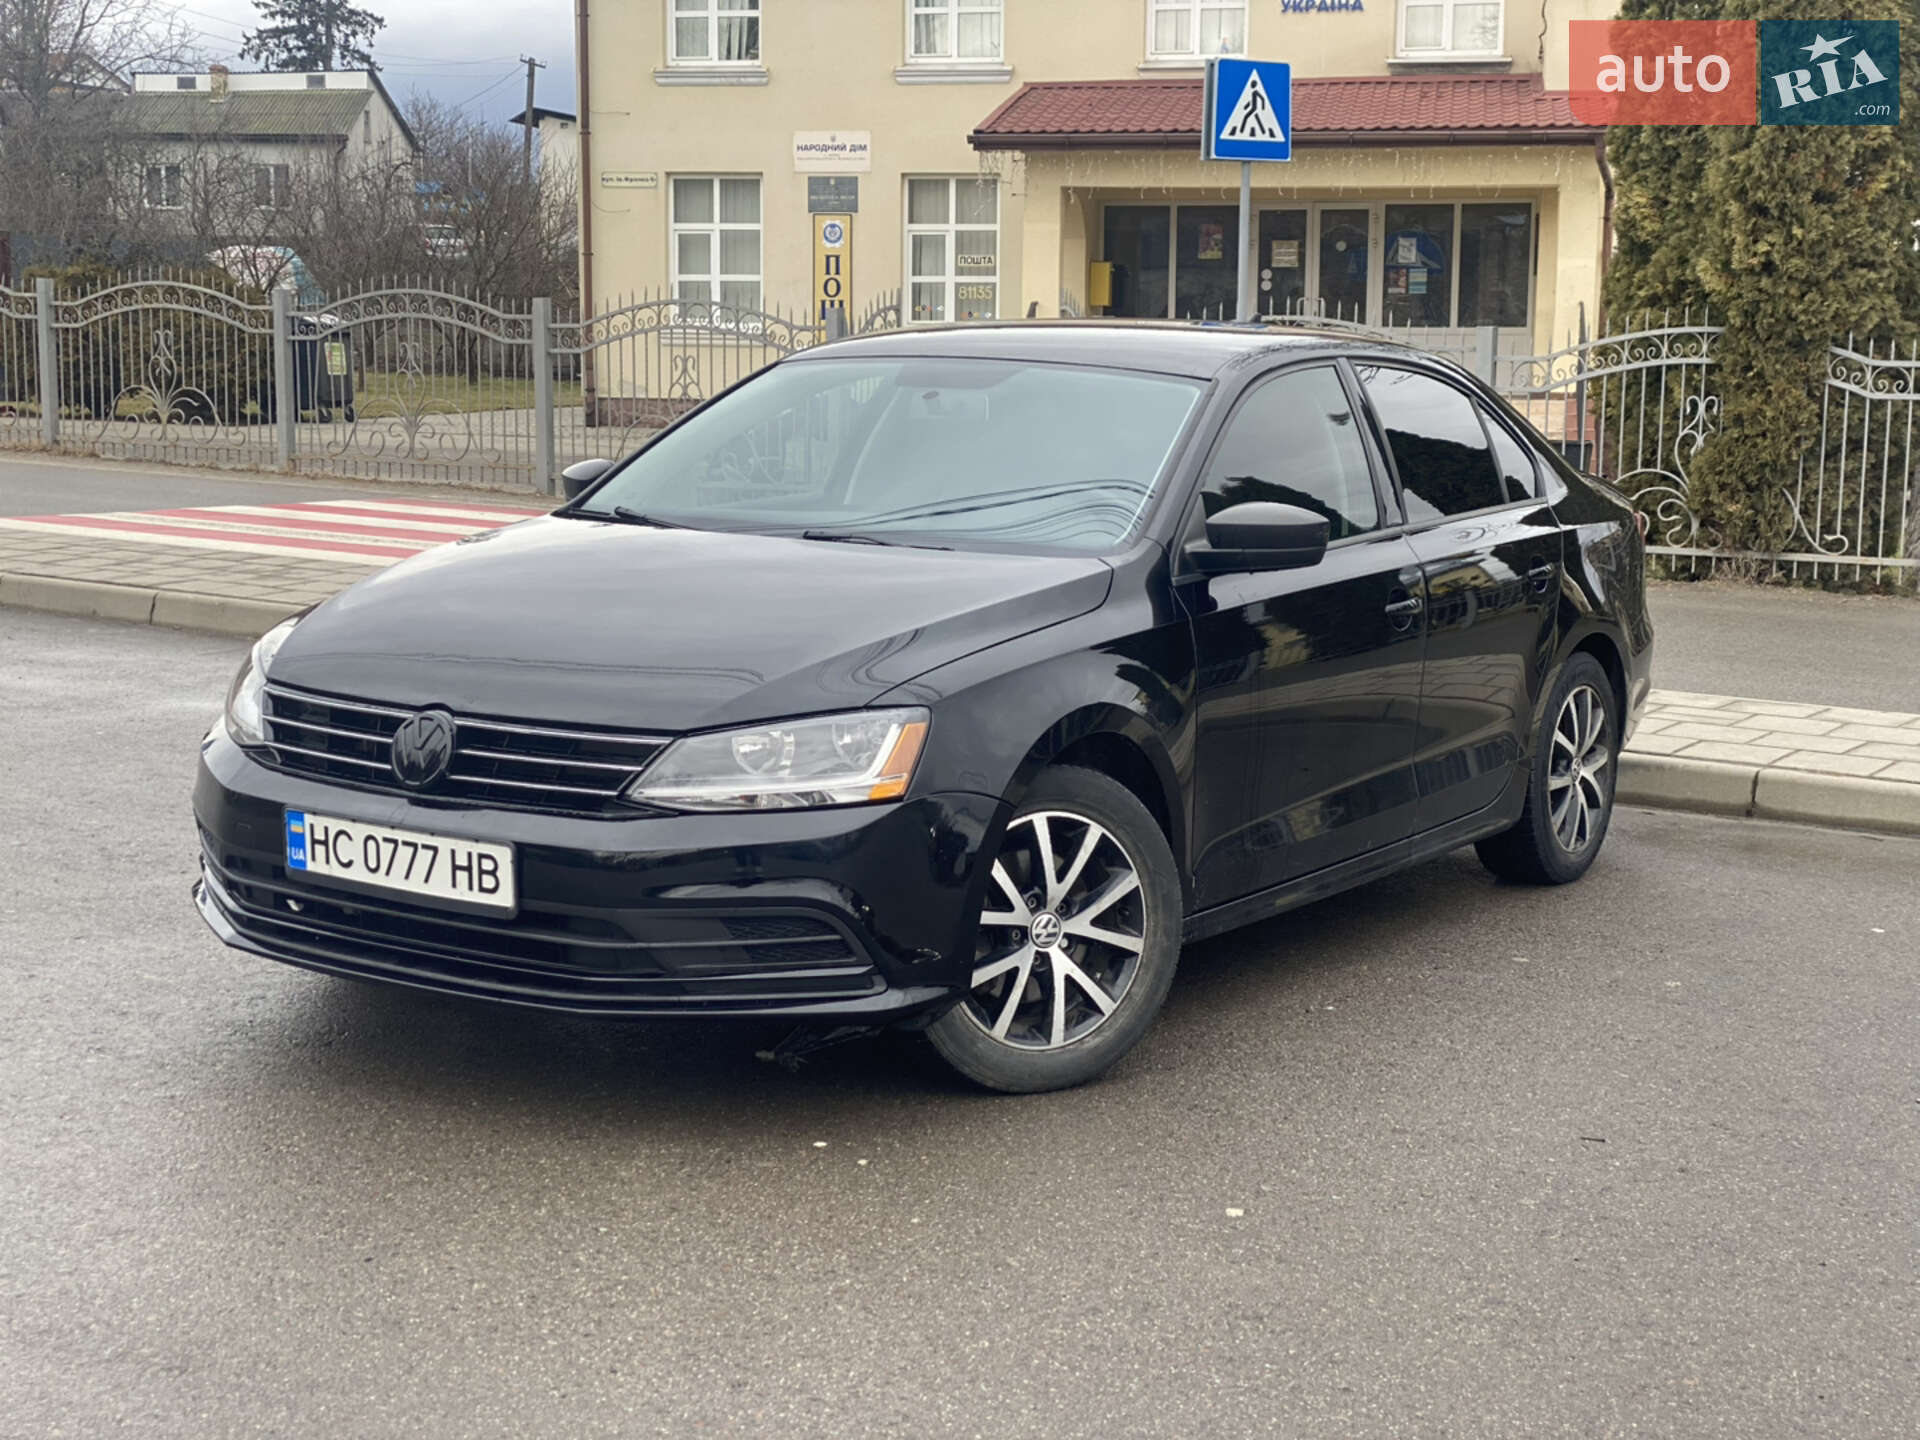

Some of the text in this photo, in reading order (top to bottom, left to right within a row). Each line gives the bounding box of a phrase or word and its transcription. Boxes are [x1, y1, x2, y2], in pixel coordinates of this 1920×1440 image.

[796, 142, 868, 153] НАРОДНИЙ ДІМ
[959, 255, 993, 265] ПОШТА
[291, 847, 305, 861] UA
[309, 823, 500, 895] HC 0777 HB
